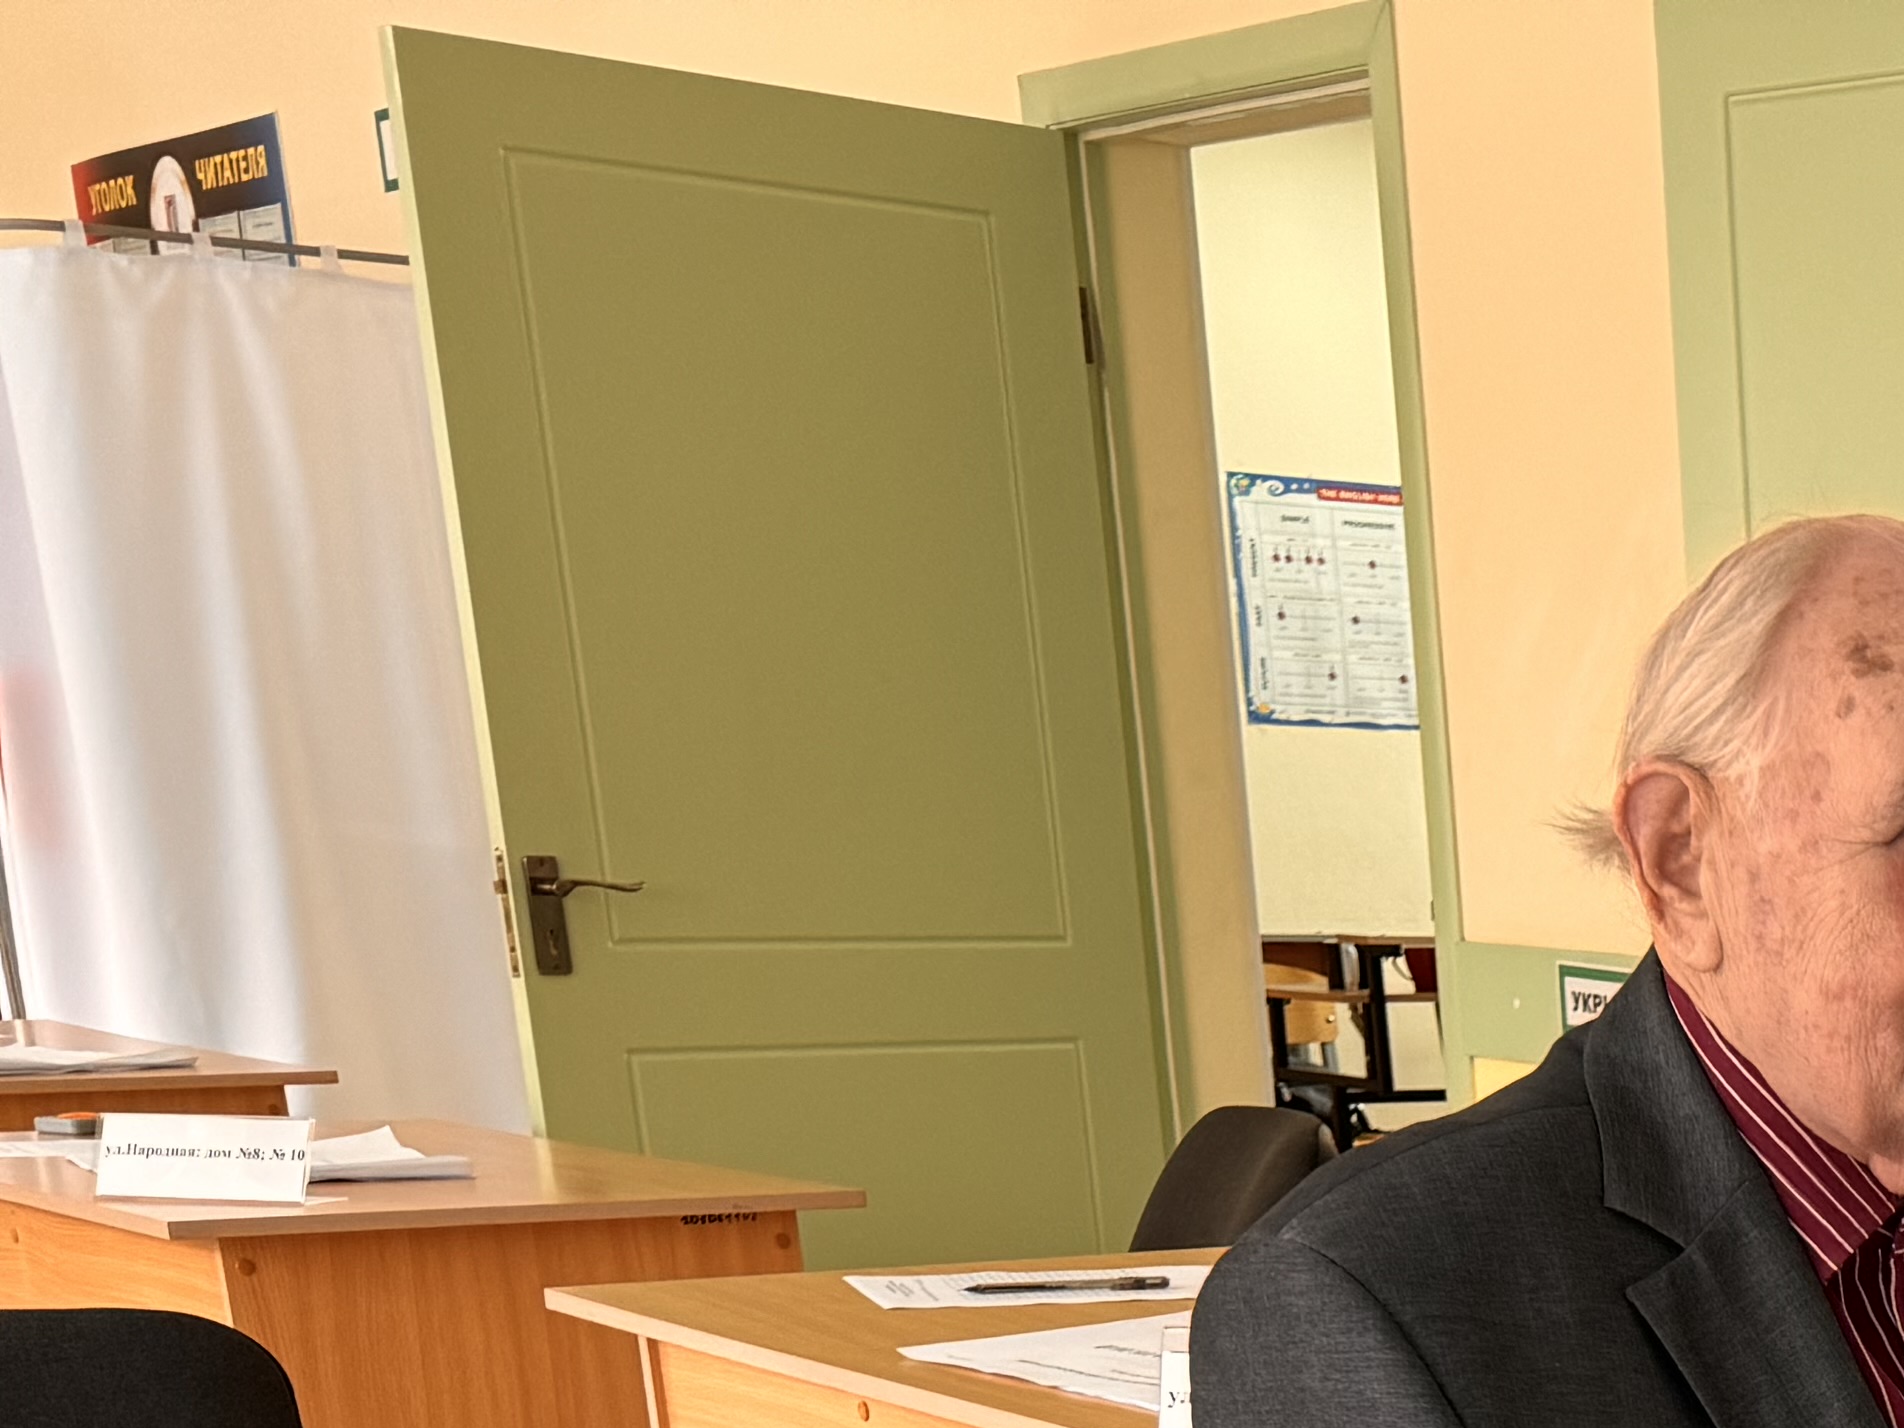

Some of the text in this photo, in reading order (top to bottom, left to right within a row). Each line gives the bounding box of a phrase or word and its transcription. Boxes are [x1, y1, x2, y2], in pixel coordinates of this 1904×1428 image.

[88, 144, 268, 216] УГОЛОК ЧИТАТЕЛЯ
[1571, 990, 1608, 1014] УКР
[204, 1148, 232, 1159] дом
[290, 1148, 306, 1161] 10
